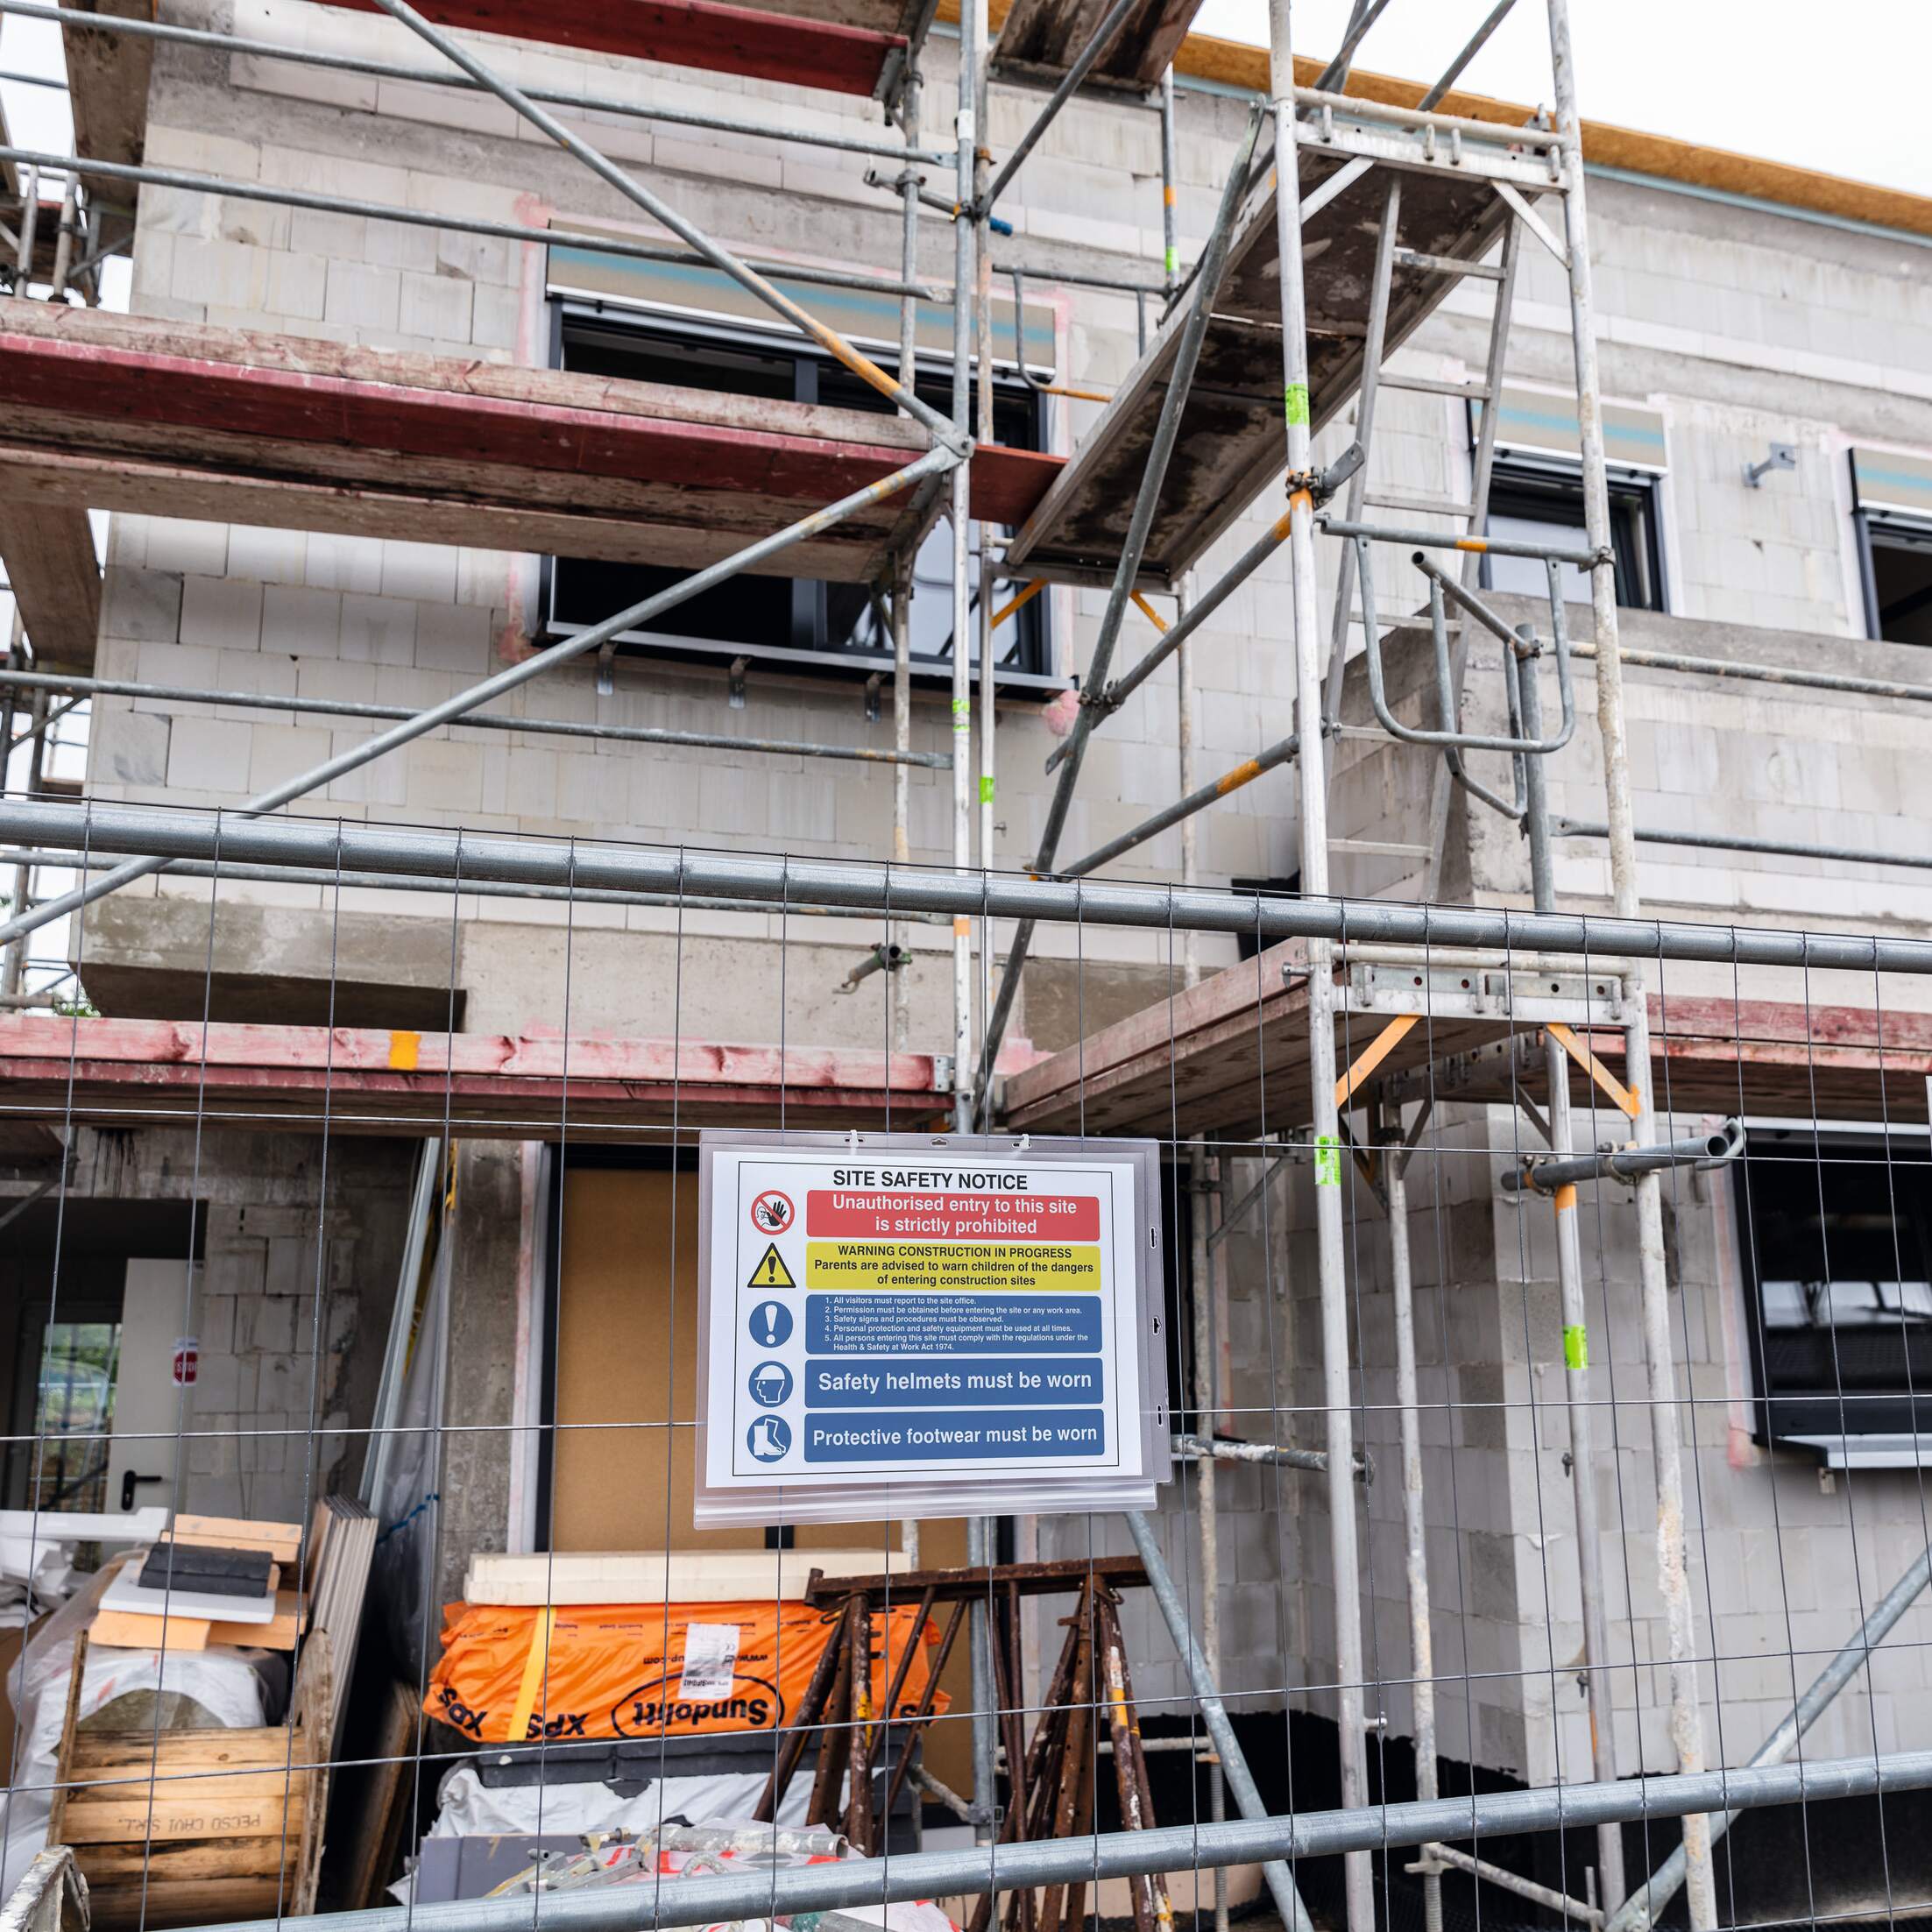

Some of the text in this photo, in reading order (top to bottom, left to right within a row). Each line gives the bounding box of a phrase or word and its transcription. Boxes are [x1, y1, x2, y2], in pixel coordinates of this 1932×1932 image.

[833, 1170, 1028, 1190] SITE SAFETY NOTICE
[833, 1194, 1077, 1215] Unauthorised entry to this site
[876, 1216, 1037, 1236] is strictly prohibited
[838, 1245, 1072, 1258] WARNING CONSTRUCTION IN PROGRESS
[815, 1259, 857, 1270] Parents
[860, 1262, 878, 1270] are
[881, 1260, 924, 1270] advised
[928, 1262, 938, 1270] to
[972, 1262, 1015, 1271] children
[1018, 1262, 1029, 1271] of
[1031, 1262, 1048, 1271] the
[1051, 1262, 1093, 1275] dangers
[877, 1274, 1036, 1287] of entering construction sites
[966, 1306, 994, 1315] entering
[833, 1315, 857, 1324] Safety
[859, 1315, 879, 1325] signs
[896, 1315, 938, 1324] procedures
[868, 1325, 905, 1334] protection
[922, 1325, 944, 1334] safety
[945, 1325, 983, 1334] equipment
[877, 1334, 907, 1343] entering
[959, 1334, 984, 1343] comply
[1016, 1334, 1054, 1343] regulations
[867, 1343, 890, 1353] Safety
[818, 1371, 1091, 1394] Safety helmets must be worn
[814, 1426, 1097, 1446] Protective footwear must be worn
[633, 1699, 768, 1726] Sundolitt
[527, 1712, 590, 1738] XPS
[118, 1818, 161, 1832] SR.L.
[211, 1815, 260, 1830] PECSO
